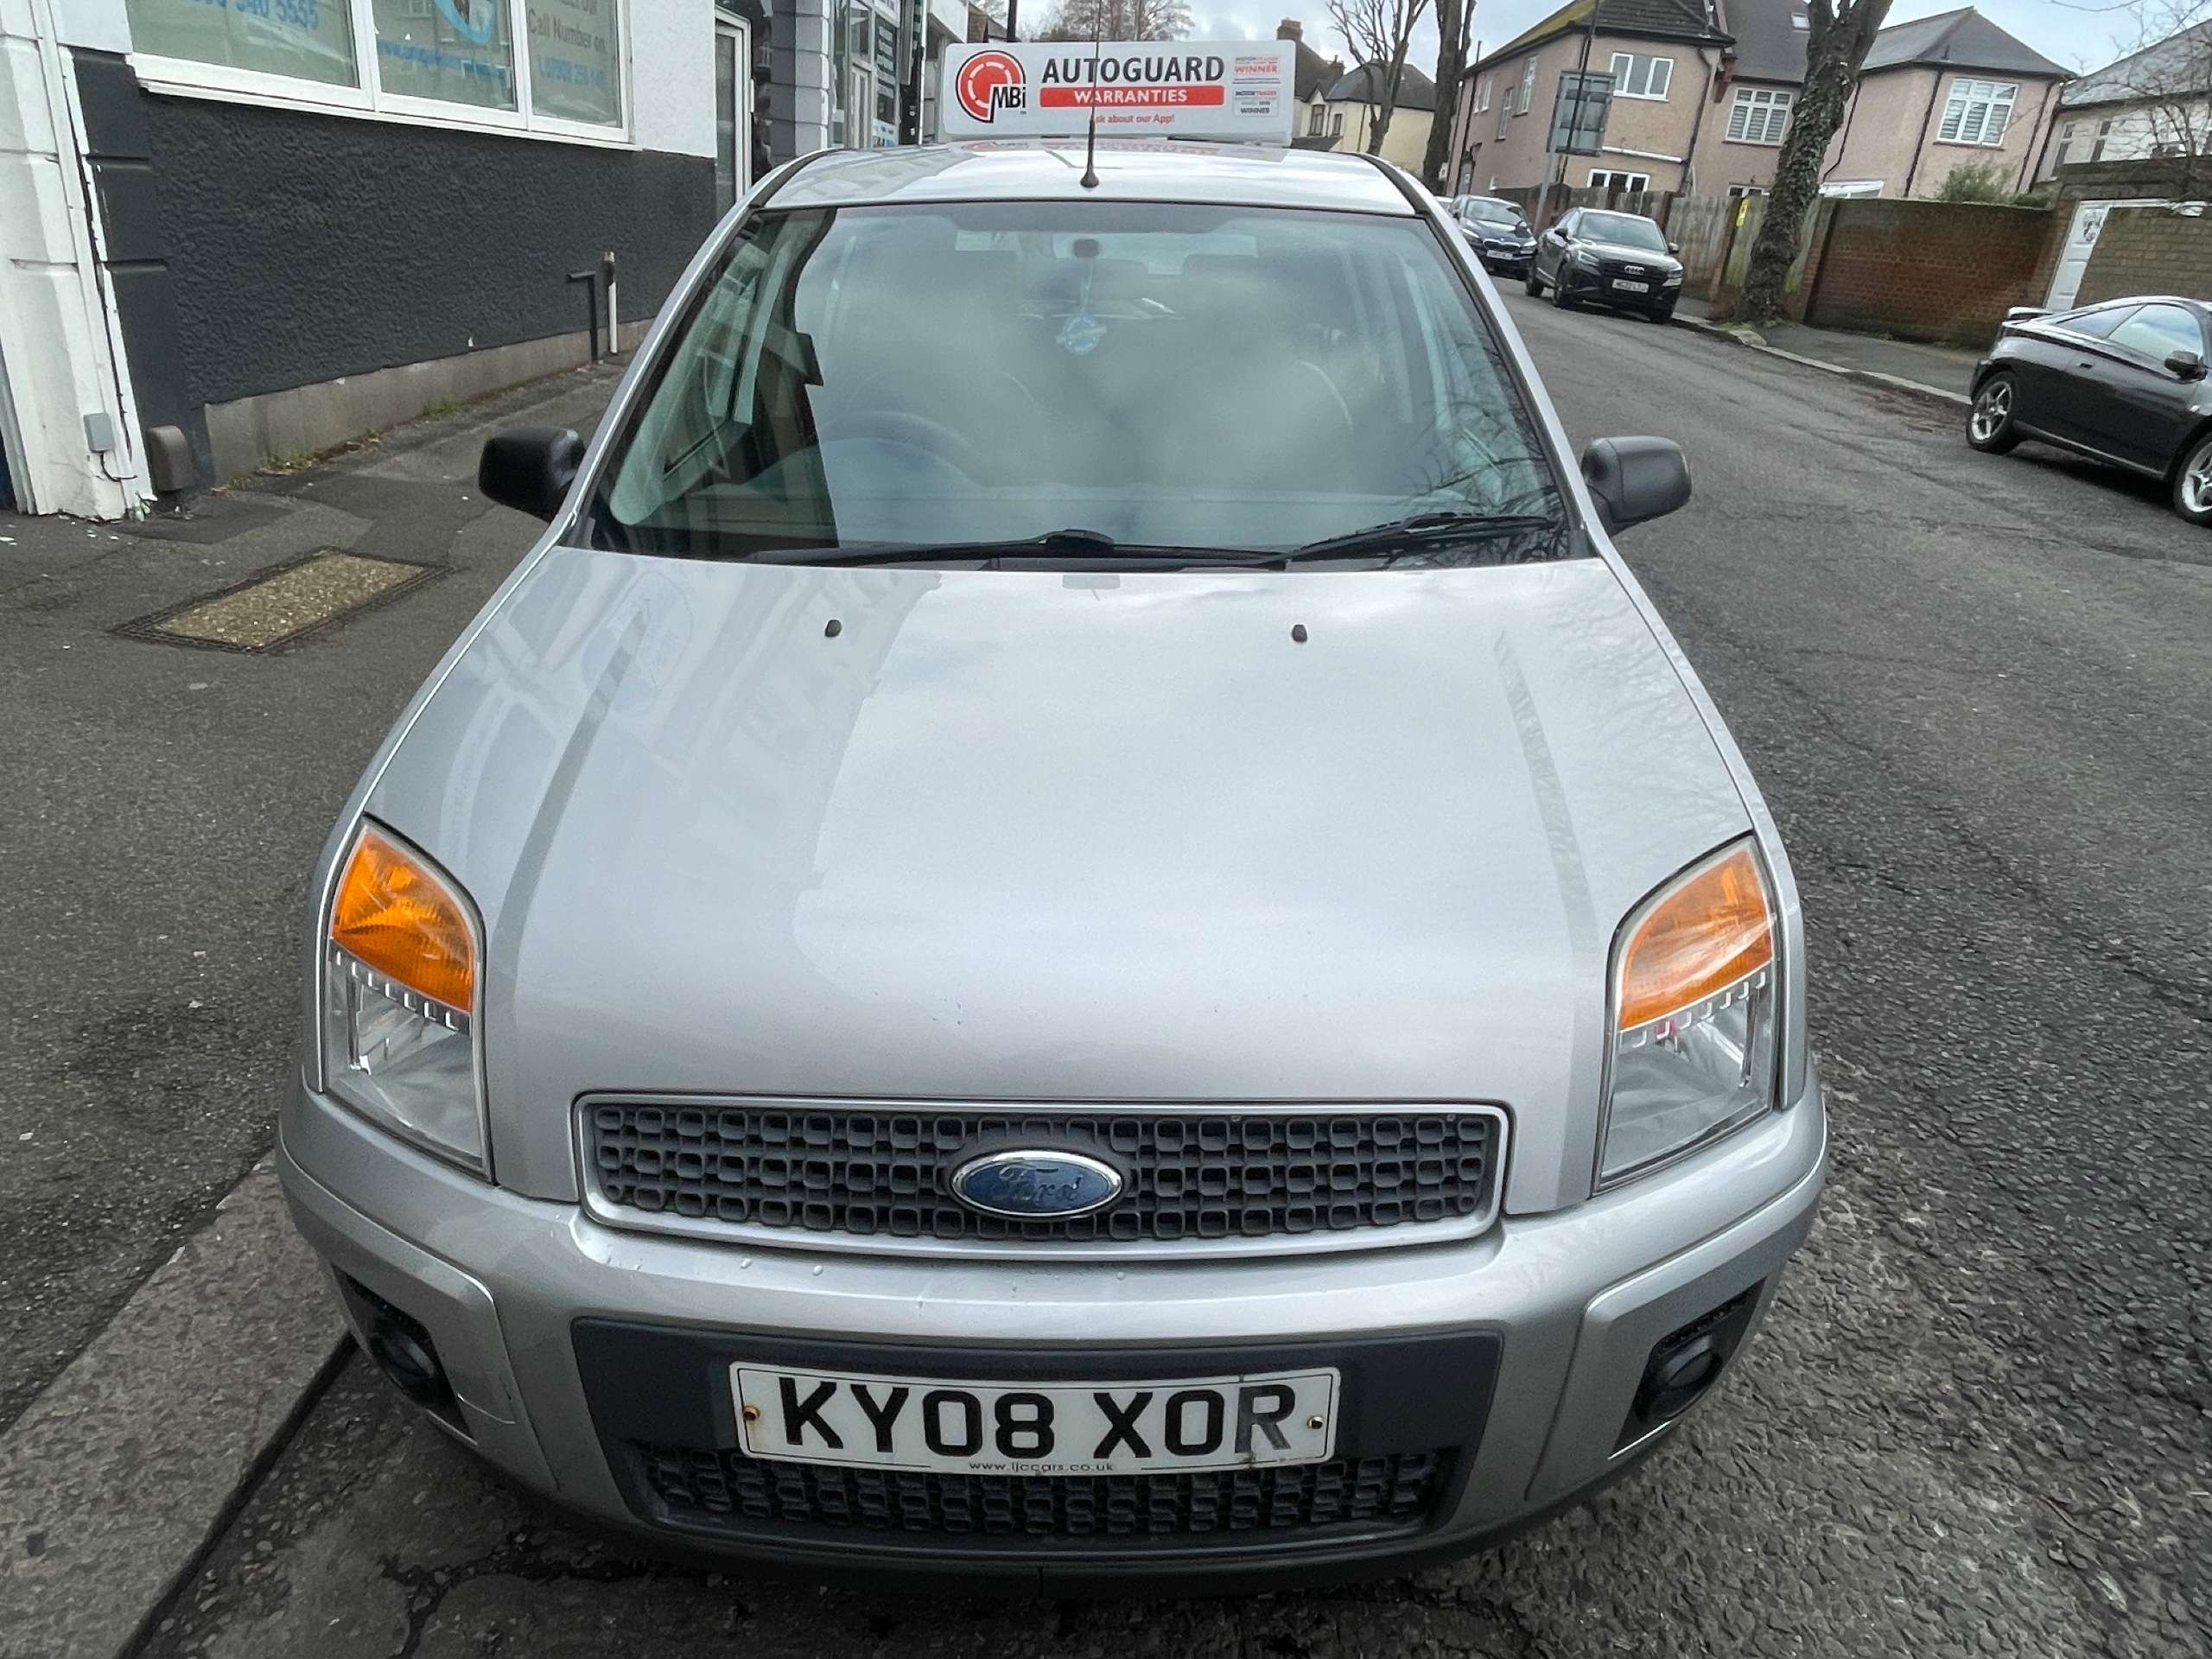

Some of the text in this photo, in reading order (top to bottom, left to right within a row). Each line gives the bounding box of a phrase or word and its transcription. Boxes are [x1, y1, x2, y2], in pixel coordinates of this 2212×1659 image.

[1041, 56, 1224, 83] AUTOGUARD
[1074, 89, 1188, 103] WARRANTIES
[1108, 114, 1134, 124] about
[778, 1377, 1296, 1459] KY08 XOR
